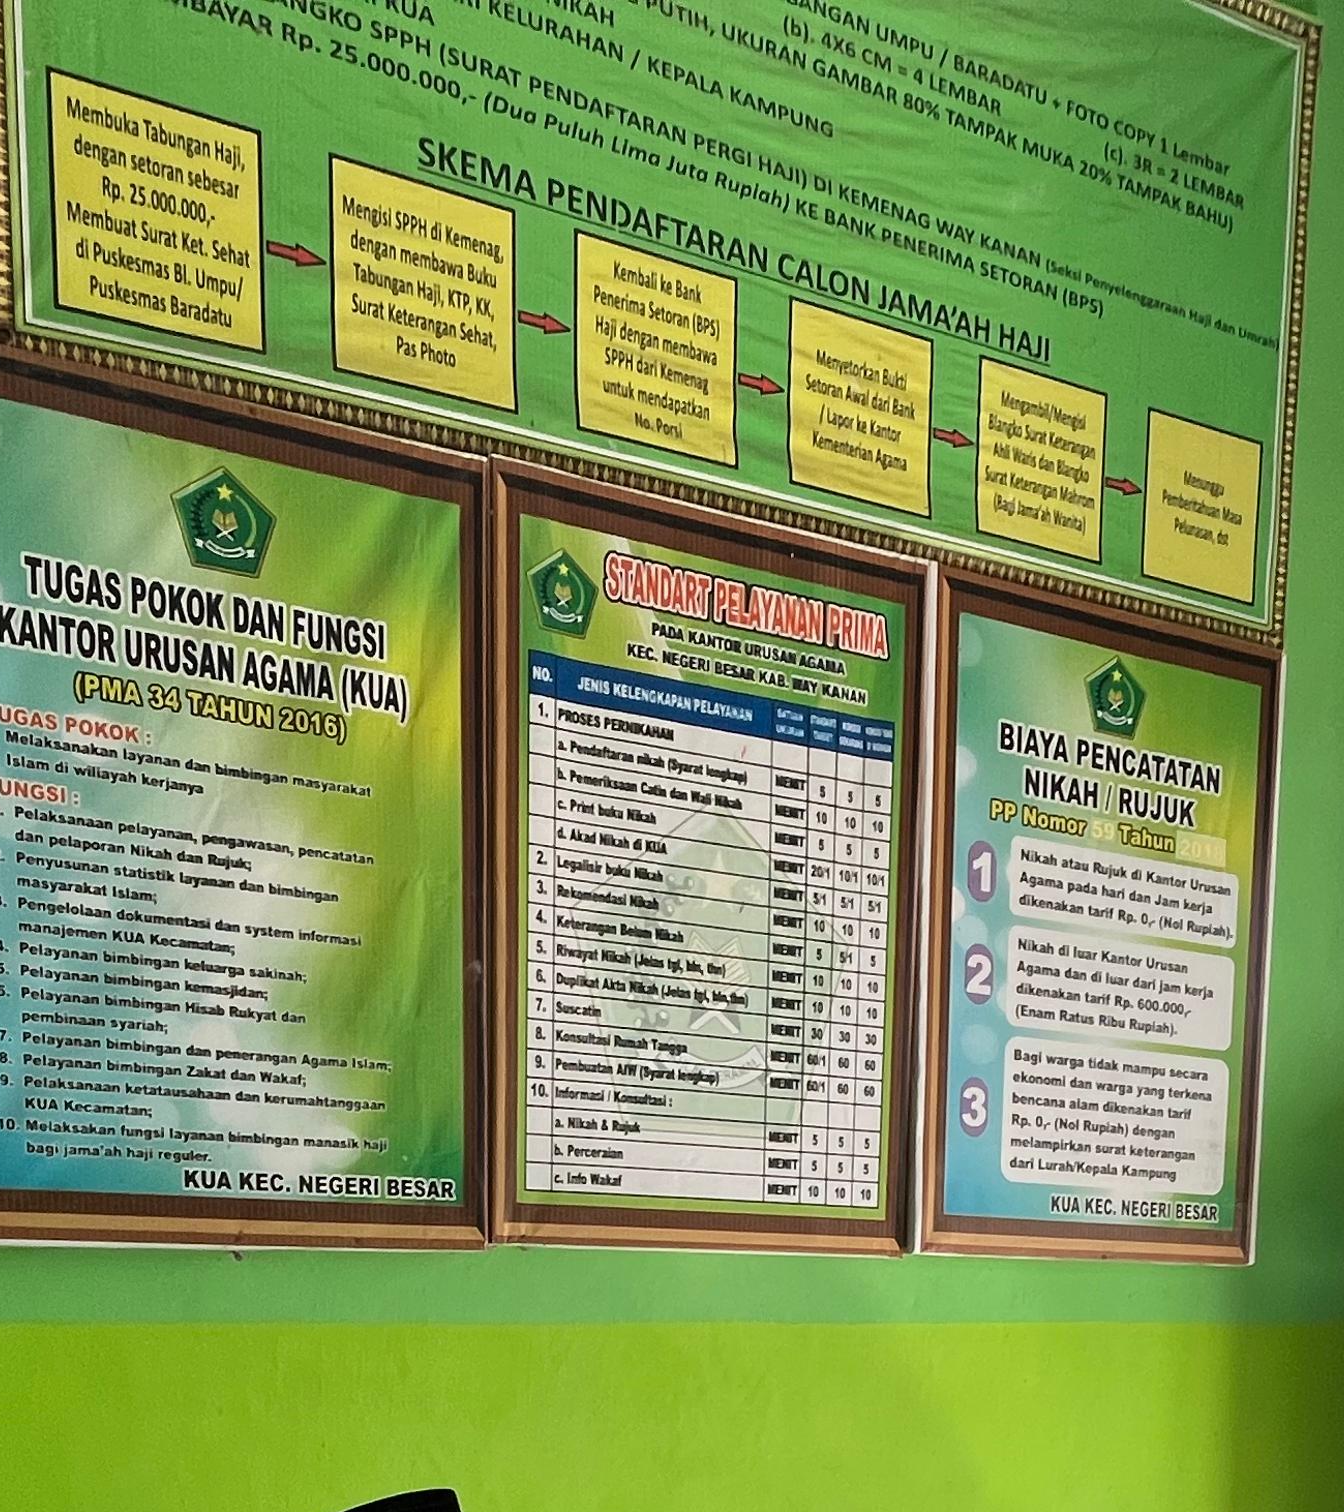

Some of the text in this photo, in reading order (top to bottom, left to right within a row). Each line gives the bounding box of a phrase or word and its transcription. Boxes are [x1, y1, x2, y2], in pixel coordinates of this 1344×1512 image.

[66, 96, 245, 170] Membuka Tabungan Haji,
[369, 19, 1042, 271] SPPH (SURAT PENDAFTARAN PERGI HAJI) DI KEMENAG WAY KANAN
[73, 134, 239, 198] dengan setoran sebesar
[281, 22, 1105, 318] Rp. 25.000.000,- (Dua Puluh Lima Juta Rupiah) KE BANK PENERIMA SETORAN (BPS)
[102, 175, 216, 225] Rp. 25.000.000,-
[342, 194, 504, 264] Mengisi SPPH di Kemenag,
[66, 201, 250, 268] Membuat Surat Ket. Sehat
[350, 229, 497, 289] dengan membawa Buku
[417, 137, 1052, 363] SKEMA PENDAFTARAN CALON JAMA'AH HAJI
[75, 240, 244, 298] di Puskesmas Bl. Umpu/
[354, 263, 495, 322] Tabungan Haji, KTP, KK,
[89, 274, 232, 329] Puskesmas Baradatu
[351, 293, 497, 352] Surat Keterangan Sehat,
[396, 334, 456, 368] Pas Photo
[22, 554, 386, 660] TUGAS POKOK DAN FUNGSI
[604, 554, 889, 657] STANDART PELAYANAN PRIMA
[123, 627, 236, 684] URUSAN
[242, 647, 335, 702] AGAMA
[340, 667, 409, 723] (KUA)
[531, 664, 554, 684] NO.
[626, 642, 868, 705] KEC. NEGERI BESAR KAB. WAY KANAN
[651, 622, 845, 676] PADA KANTOR URUSAN AGAMA
[64, 714, 140, 743] POKOK
[144, 730, 153, 745] :
[72, 671, 348, 744] (PMA 34 TAHUN 2016)
[5, 729, 371, 798] Melaksanakan layanan dan bimbingan masyarakat
[1000, 722, 1220, 794] BIAYA PENCATATAN
[72, 793, 81, 805] :
[989, 799, 1019, 825] PP
[1021, 805, 1088, 837] Nomor
[1118, 823, 1177, 853] Tahun
[1025, 768, 1194, 827] NIKAH / RUJUK
[971, 851, 992, 893] 1
[19, 942, 98, 963] Pelayanan
[102, 950, 180, 972] bimbingan
[184, 958, 245, 979] keluarga
[249, 964, 307, 985] sakinah;
[965, 953, 993, 996] 2
[1017, 938, 1188, 974] Nikah di luar Kantor Urusan
[1015, 1004, 1177, 1036] (Enam Ratus Ribu Rupiah).
[960, 1085, 988, 1128] 3
[182, 1169, 456, 1200] KUA KEC. NEGERI BESAR
[1050, 1195, 1219, 1222] KUA KEC. NEGERI BESAR
